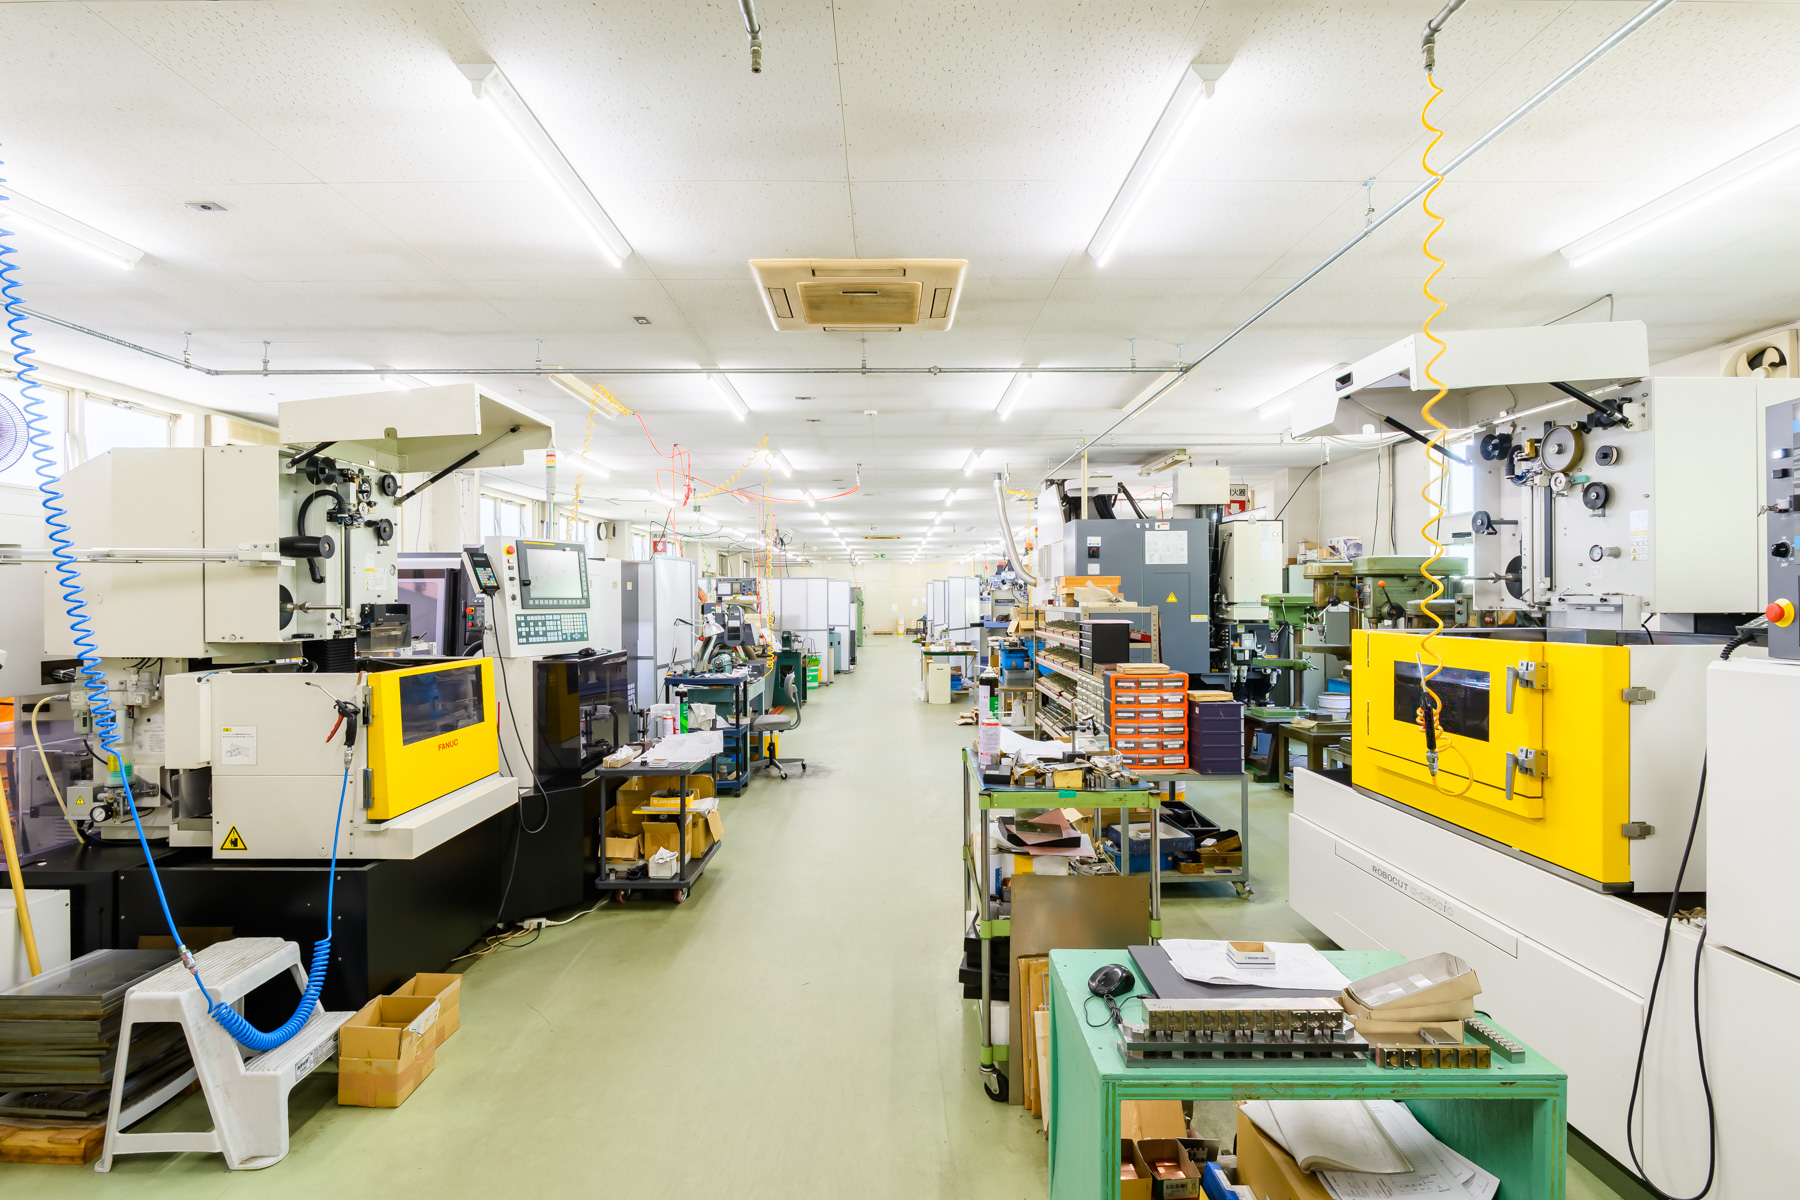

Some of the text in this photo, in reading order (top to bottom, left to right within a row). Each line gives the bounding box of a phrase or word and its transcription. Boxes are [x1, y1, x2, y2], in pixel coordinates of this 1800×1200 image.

[1230, 488, 1246, 496] 火器
[438, 738, 459, 751] FANUC
[1372, 865, 1408, 891] ROBOCUT
